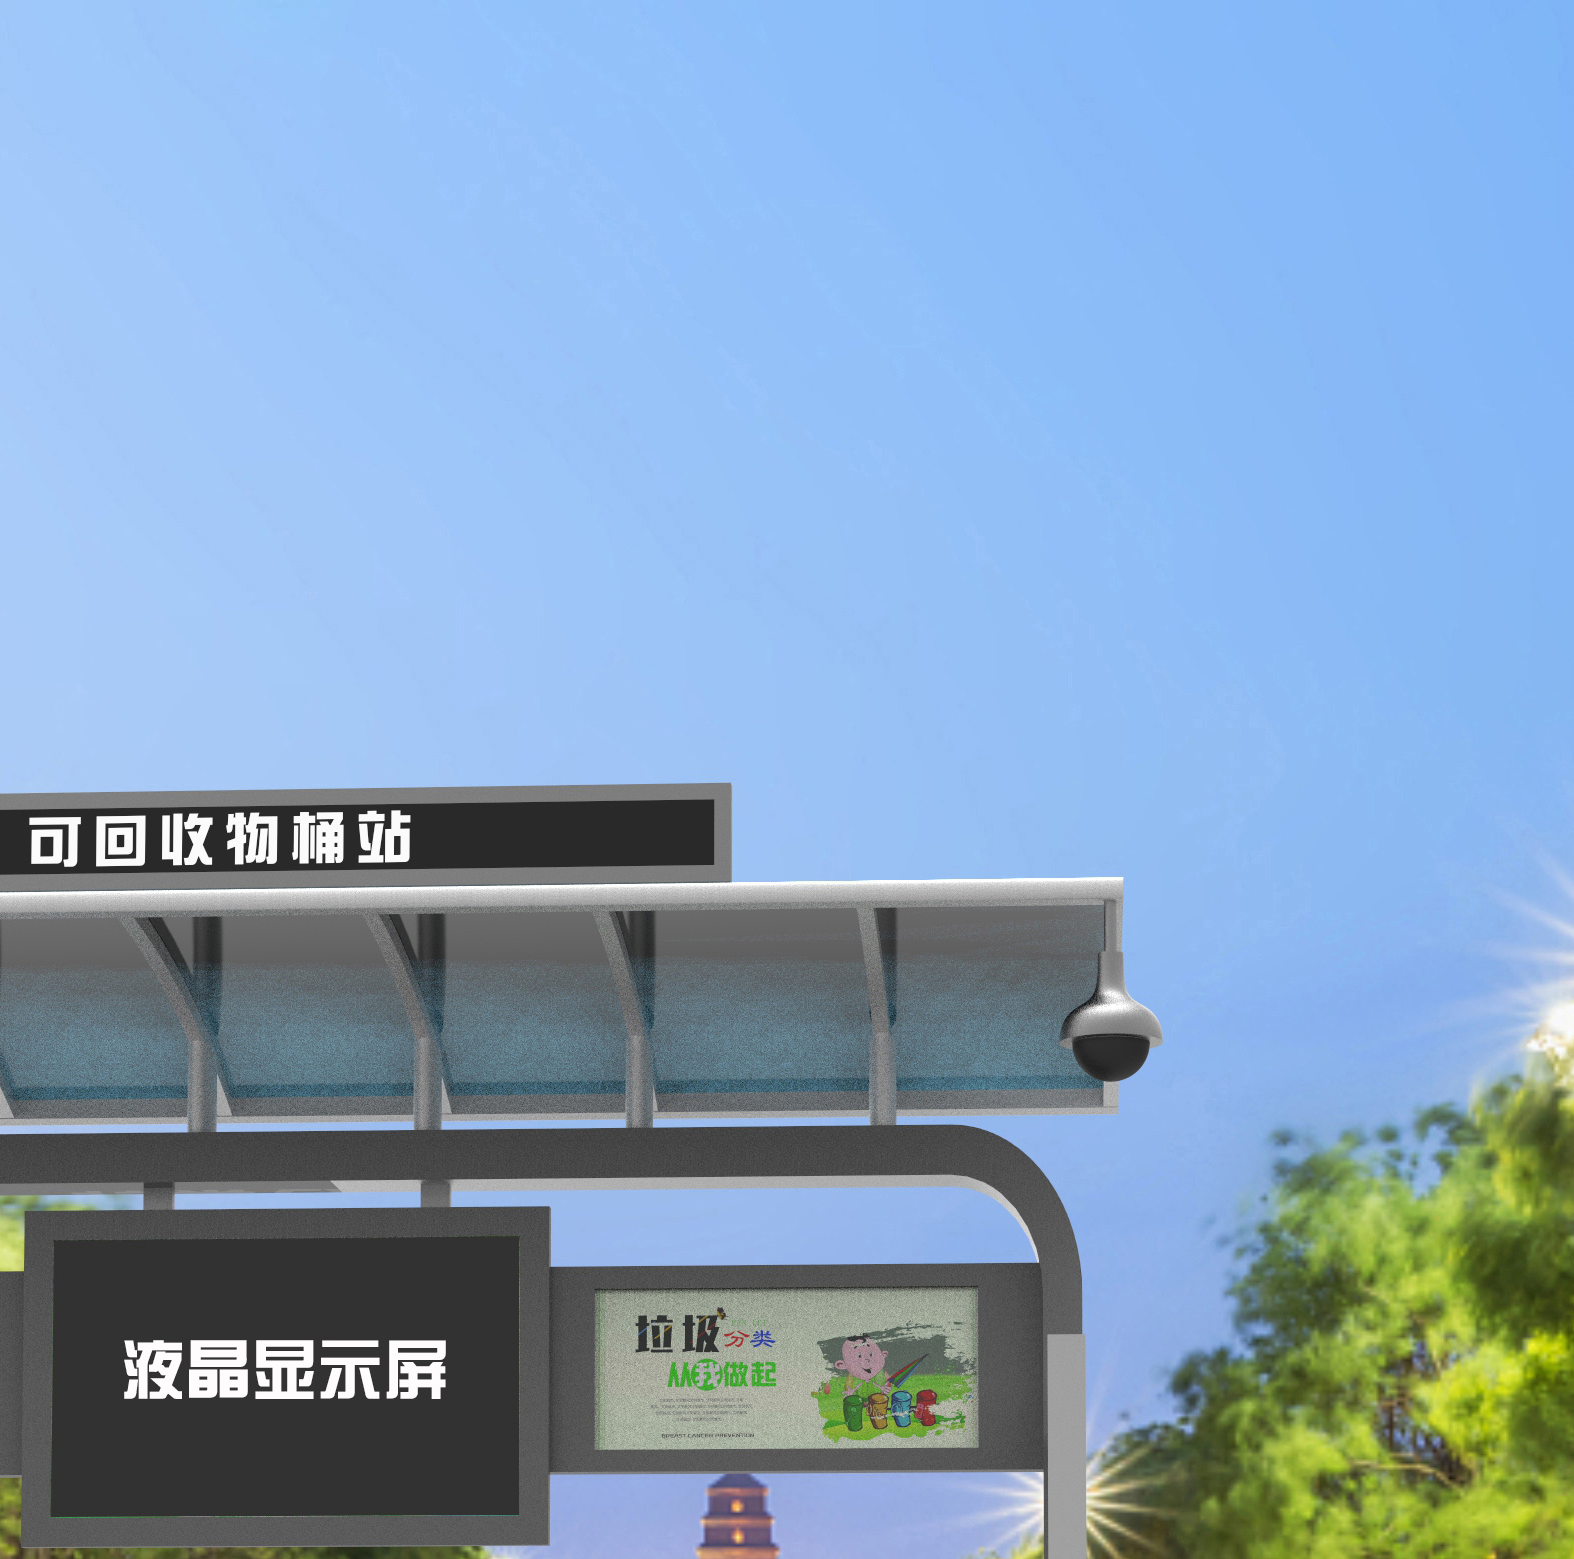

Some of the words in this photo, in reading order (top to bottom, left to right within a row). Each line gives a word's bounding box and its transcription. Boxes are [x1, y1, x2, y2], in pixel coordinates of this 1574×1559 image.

[29, 810, 411, 867] 可回收物桶站
[635, 1314, 720, 1353] 垃圾
[723, 1330, 776, 1348] 分类
[123, 1339, 447, 1400] 液晶显示屏
[667, 1359, 777, 1390] 从我做起
